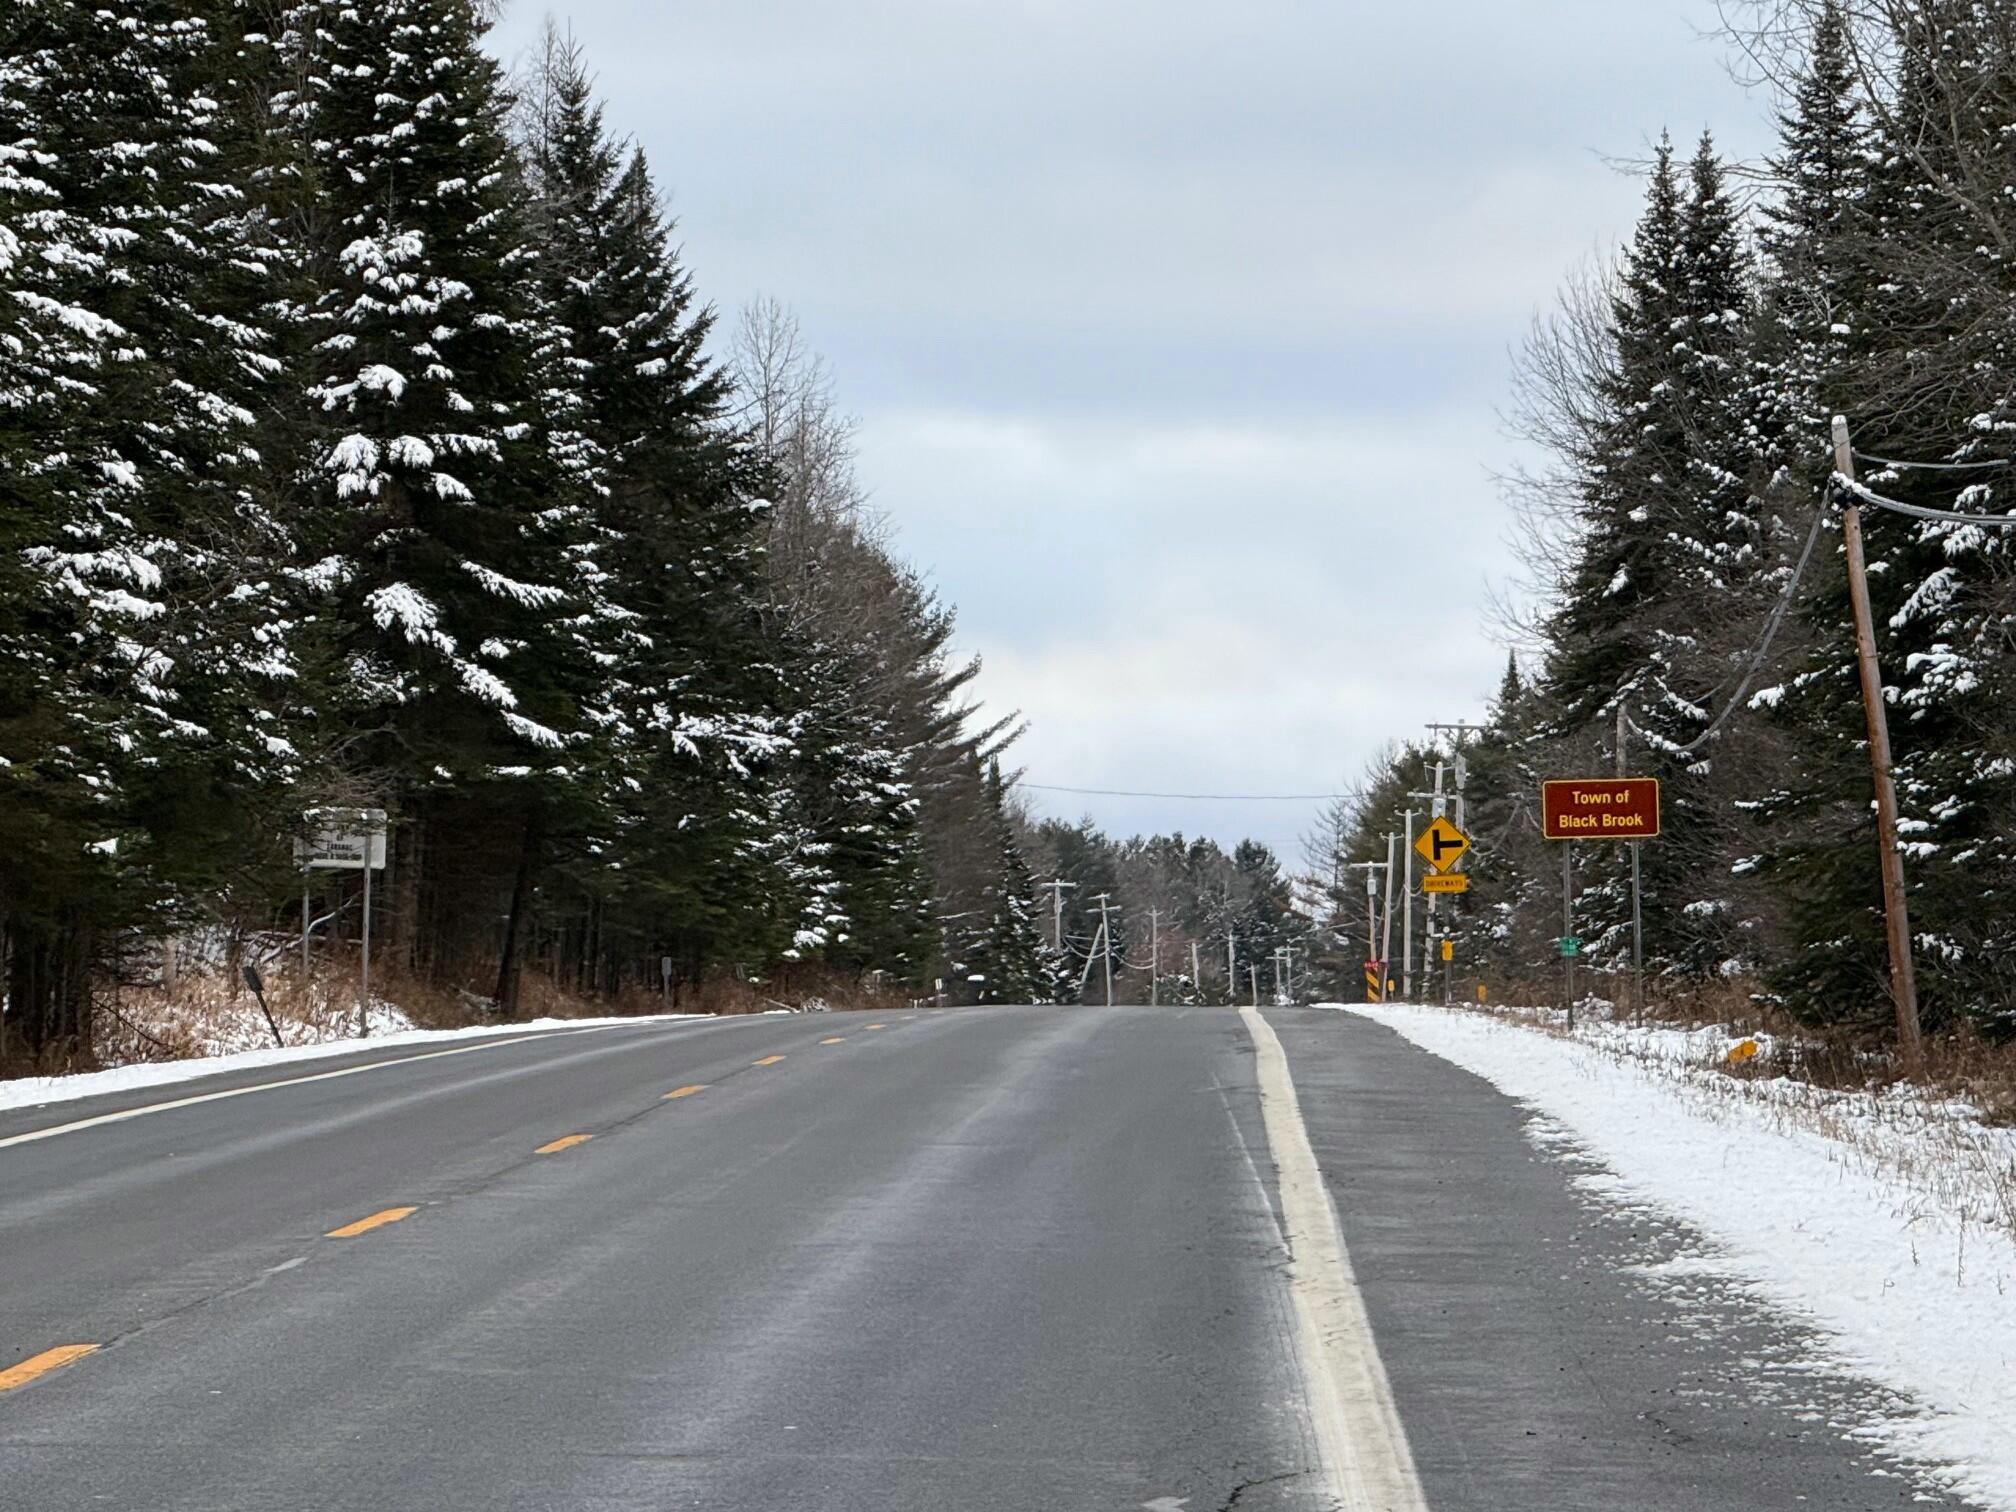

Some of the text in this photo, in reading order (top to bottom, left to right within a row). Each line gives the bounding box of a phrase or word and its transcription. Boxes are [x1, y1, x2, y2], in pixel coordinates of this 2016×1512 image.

[1572, 790, 1630, 805] Town of
[1559, 813, 1644, 828] Black Brook
